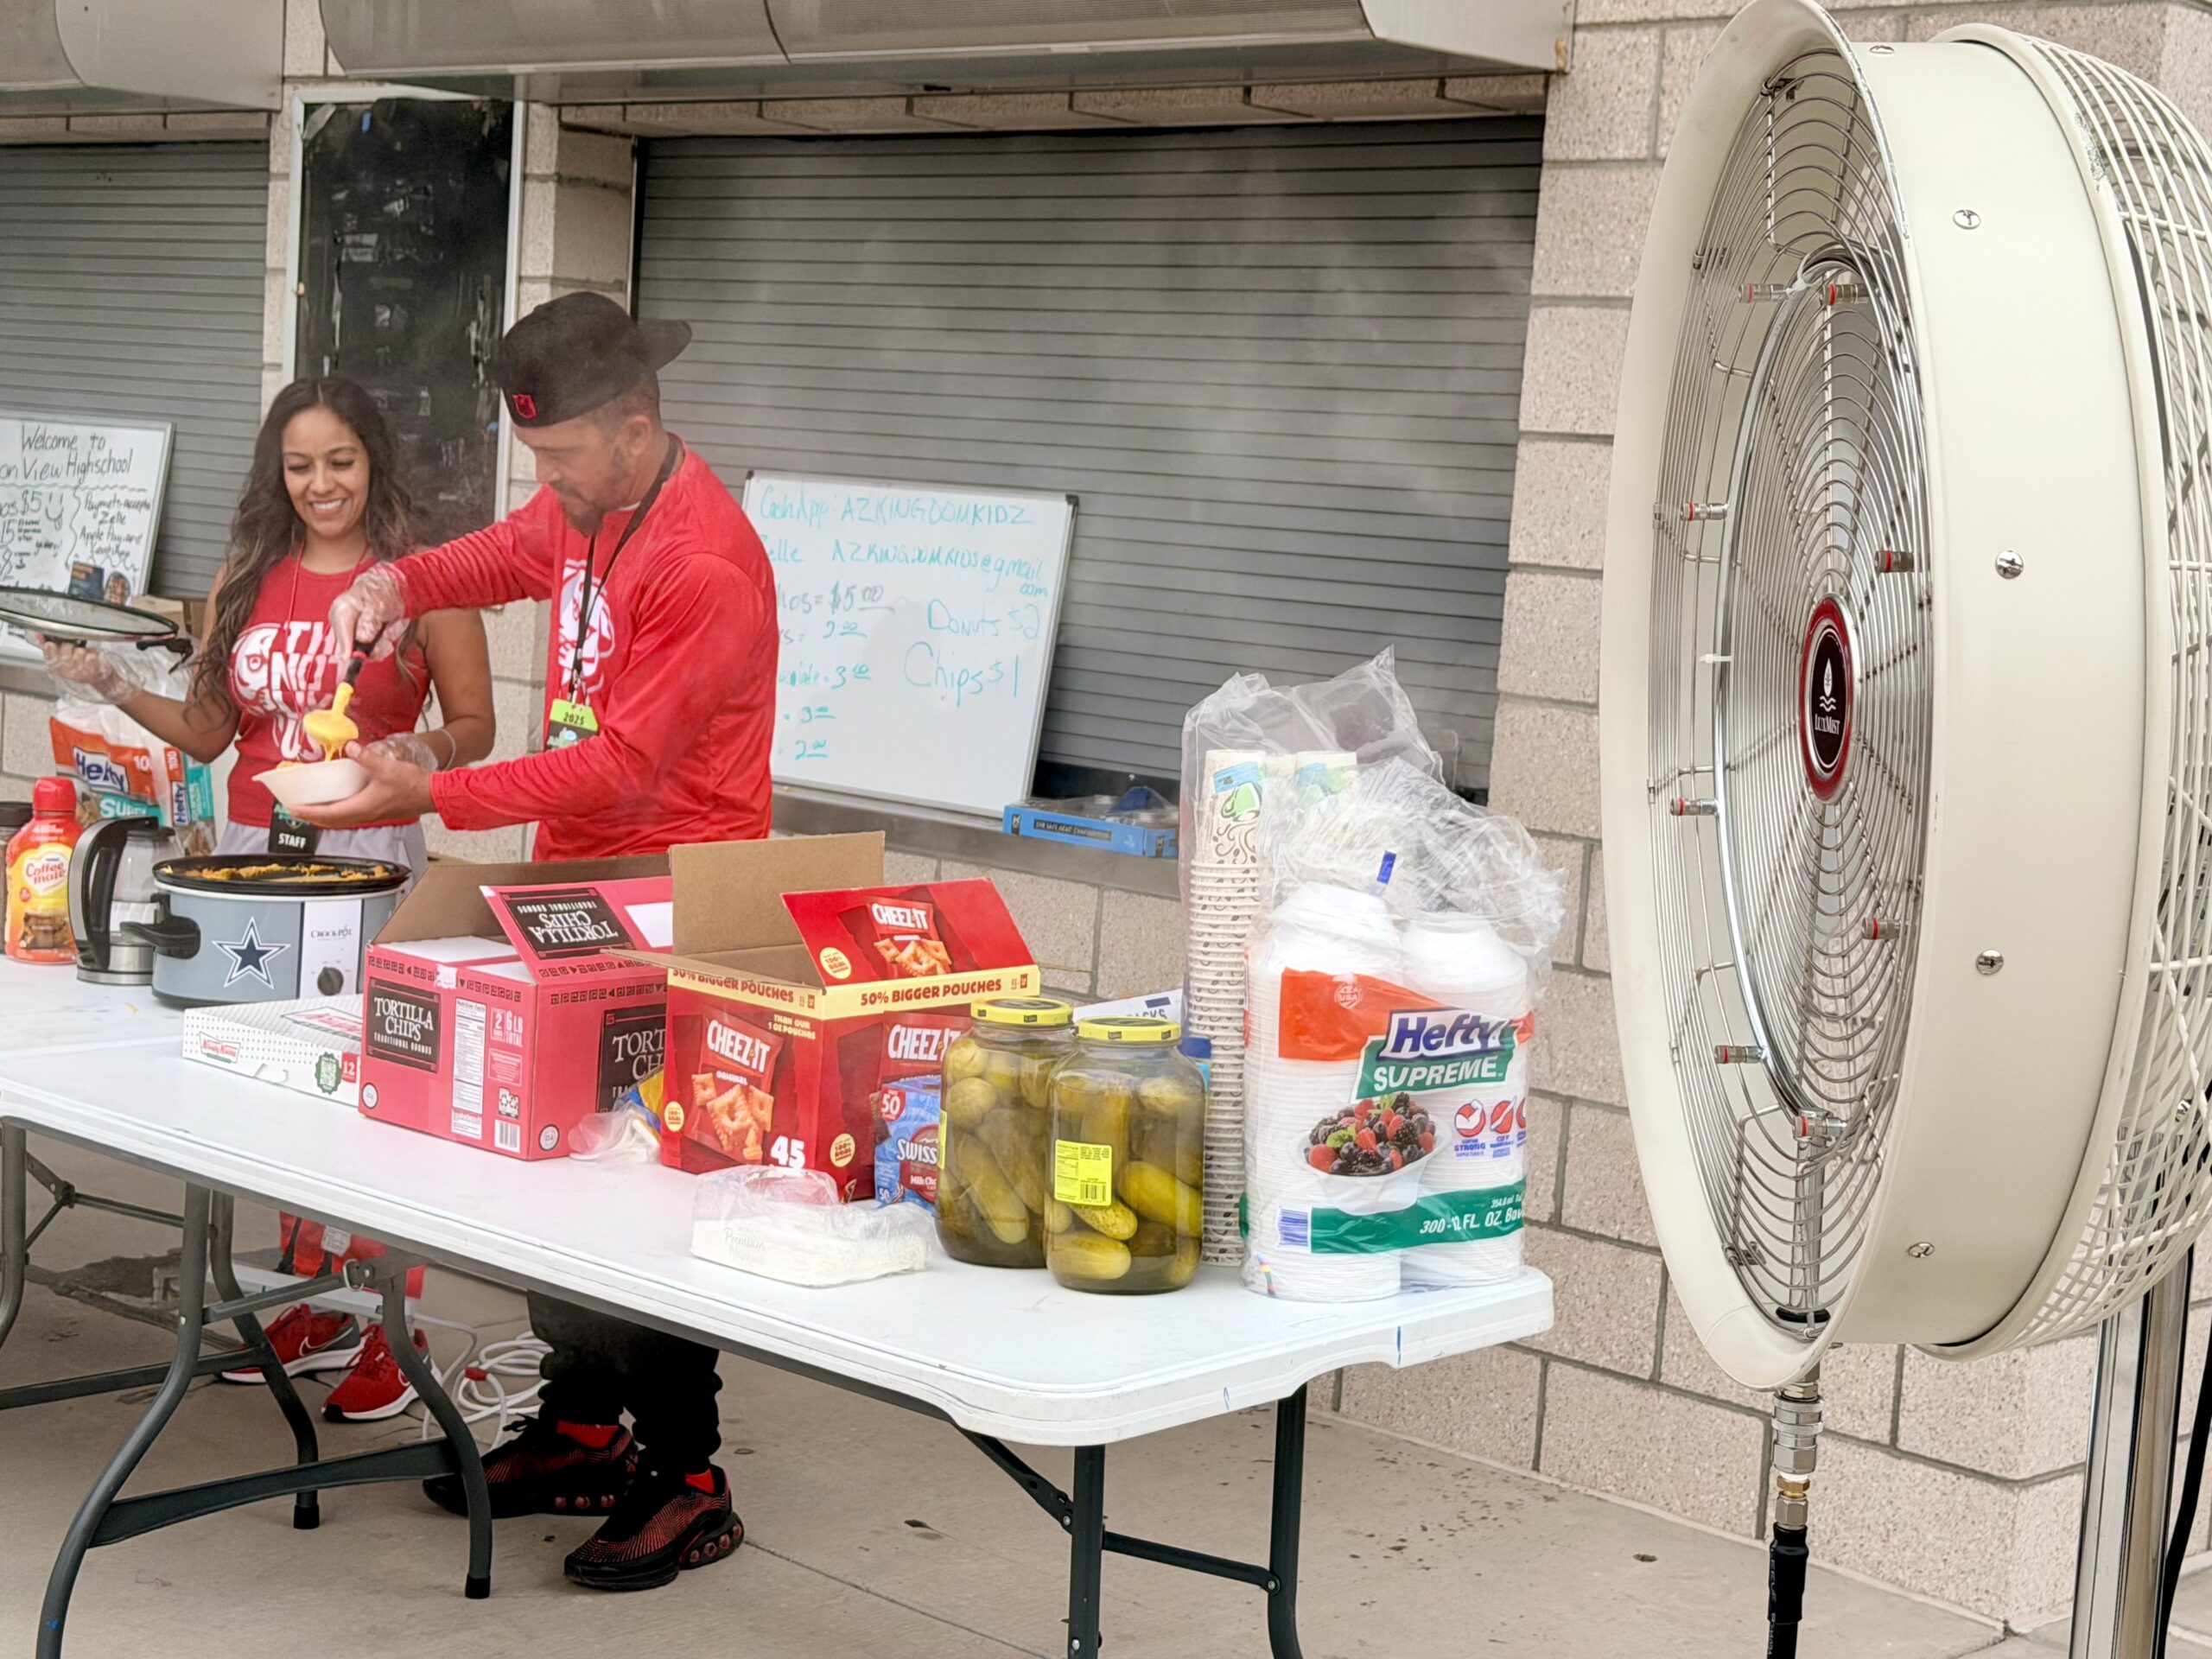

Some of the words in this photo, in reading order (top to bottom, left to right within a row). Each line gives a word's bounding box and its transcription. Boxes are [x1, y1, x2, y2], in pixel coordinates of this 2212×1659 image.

[22, 423, 78, 453] Welcome
[90, 433, 106, 450] to
[22, 457, 63, 480] View
[21, 489, 42, 516] $5
[905, 641, 983, 708] Chips
[563, 711, 584, 726] 2025
[278, 832, 306, 849] STAFF
[26, 862, 65, 878] Coffee
[34, 869, 66, 885] mate
[538, 910, 592, 928] CHIPS
[528, 921, 619, 944] TORTILLA
[741, 980, 794, 1003] POUCHES
[861, 991, 889, 1006] 50%
[892, 985, 939, 1003] BIGGER
[942, 978, 1001, 997] POUCHES
[374, 997, 434, 1031] TORTILLA
[495, 1013, 502, 1029] 2
[513, 1015, 524, 1034] LB
[773, 1014, 793, 1027] THAN
[794, 1019, 810, 1030] OUR
[385, 1016, 422, 1041] CHIPS
[1390, 1013, 1507, 1053] Hefty
[612, 1028, 666, 1063] TORT
[343, 1061, 355, 1076] 12
[1374, 1055, 1498, 1091] SUPREME
[880, 1093, 900, 1115] 50
[771, 1135, 805, 1167] 45
[897, 1138, 938, 1165] SWISS
